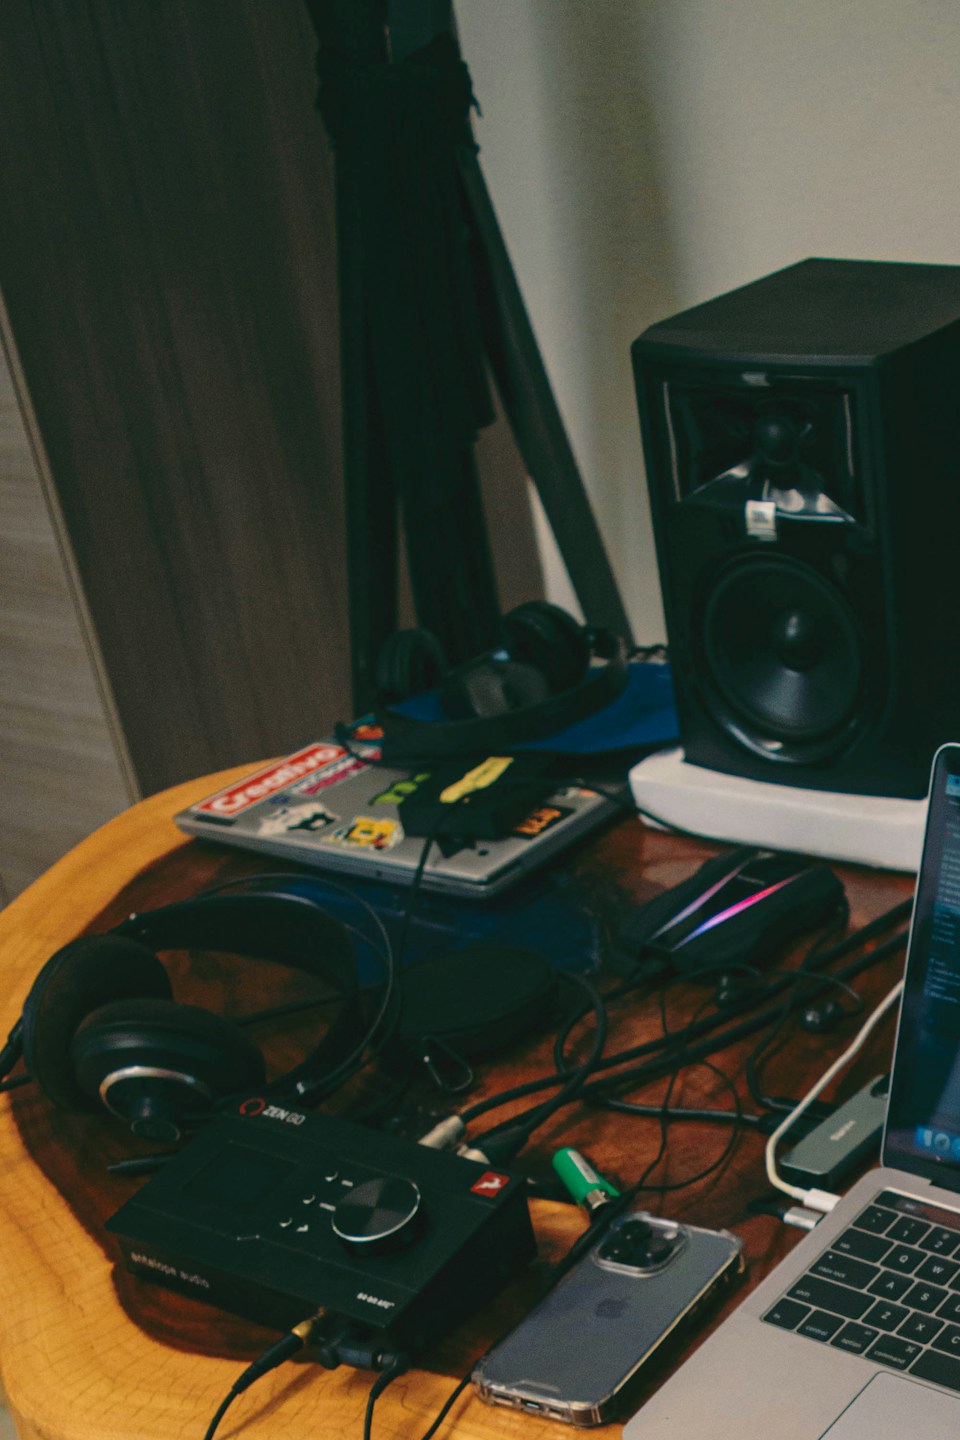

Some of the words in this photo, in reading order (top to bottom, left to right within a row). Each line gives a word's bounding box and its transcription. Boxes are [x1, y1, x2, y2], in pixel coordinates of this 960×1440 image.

[262, 1105, 288, 1122] ZEN
[286, 1112, 306, 1126] GO
[873, 1348, 906, 1366] command
